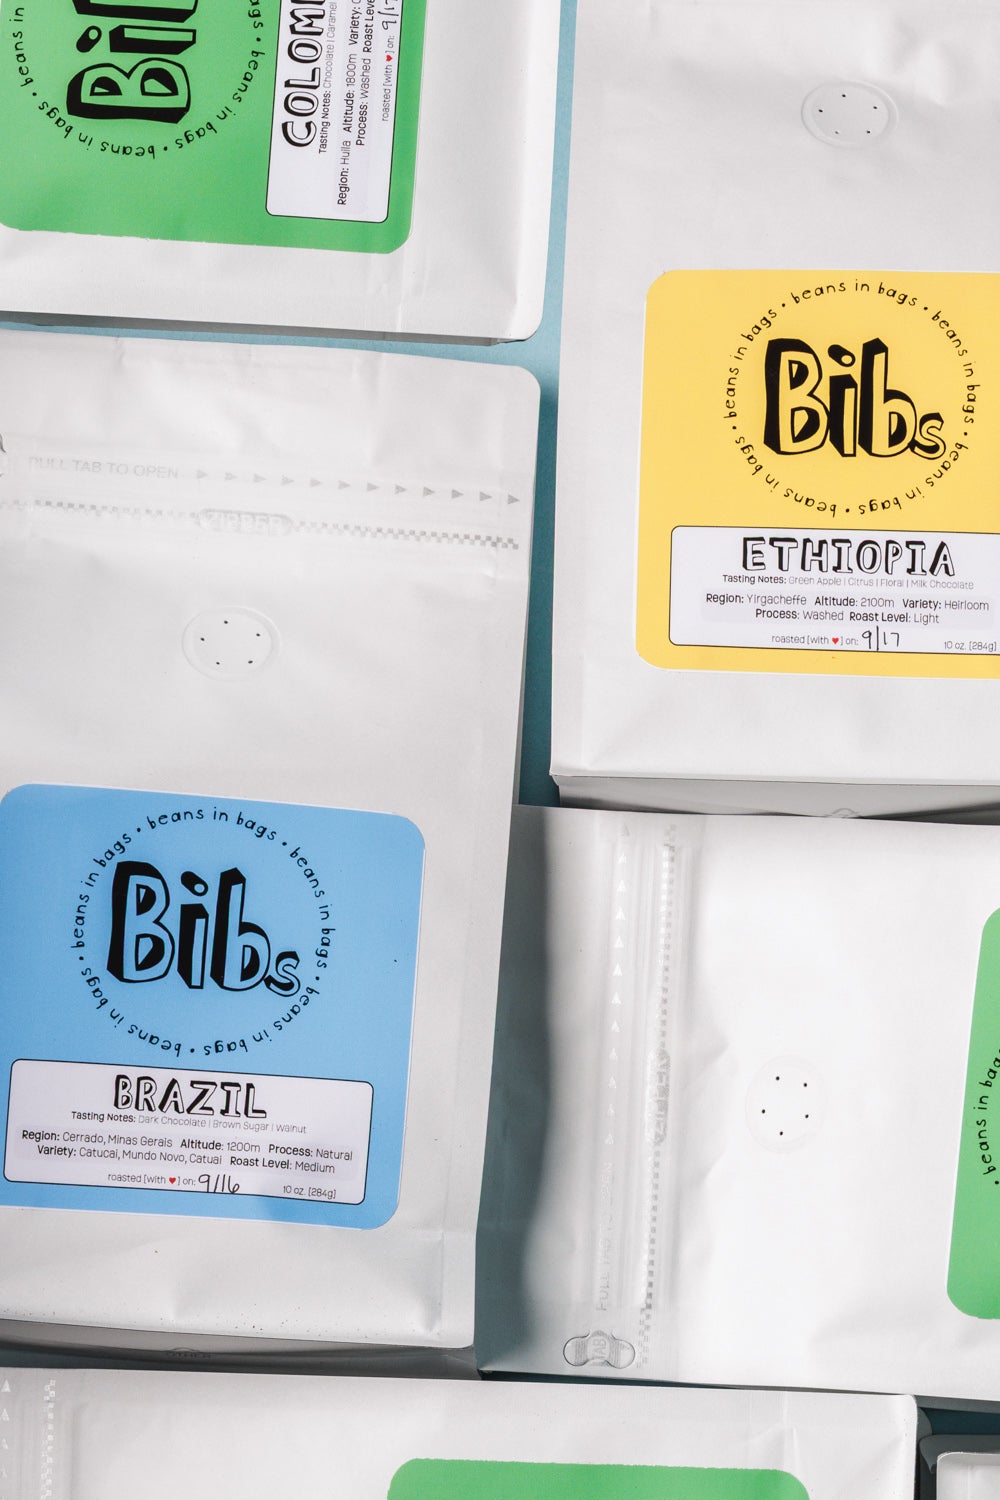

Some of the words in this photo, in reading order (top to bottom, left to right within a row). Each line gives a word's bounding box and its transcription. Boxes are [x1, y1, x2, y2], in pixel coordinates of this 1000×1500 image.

[348, 6, 364, 45] Variety:
[345, 53, 359, 87] 1800m
[341, 89, 357, 135] Altitude:
[339, 136, 354, 165] Huila
[336, 167, 351, 205] Region:
[790, 281, 846, 305] beans
[855, 279, 870, 292] in
[878, 281, 918, 307] bags
[764, 338, 946, 460] Bibs
[742, 536, 955, 576] ETHIOPIA
[705, 593, 744, 605] Region:
[745, 593, 807, 607] Yirgacheffe
[814, 595, 859, 607] Altitude:
[860, 597, 894, 608] 2100m
[902, 598, 941, 611] Variety:
[944, 599, 989, 611] Heirloom
[755, 608, 800, 619] Process:
[802, 610, 844, 621] Washed
[849, 611, 879, 622] Roast
[881, 611, 911, 623] Level:
[913, 613, 939, 626] Light
[862, 625, 899, 650] 9/17
[107, 861, 300, 997] Bibs
[113, 1074, 267, 1118] BRAZIL
[37, 1143, 76, 1158] Variety:
[78, 1146, 120, 1160] Catucai,
[122, 1149, 157, 1160] Mundo
[159, 1151, 187, 1165] Novo,
[189, 1153, 222, 1165] Catuai
[229, 1155, 259, 1167] Roast
[262, 1157, 292, 1170] Level:
[294, 1160, 335, 1173] Medium
[196, 1174, 240, 1194] 9/16
